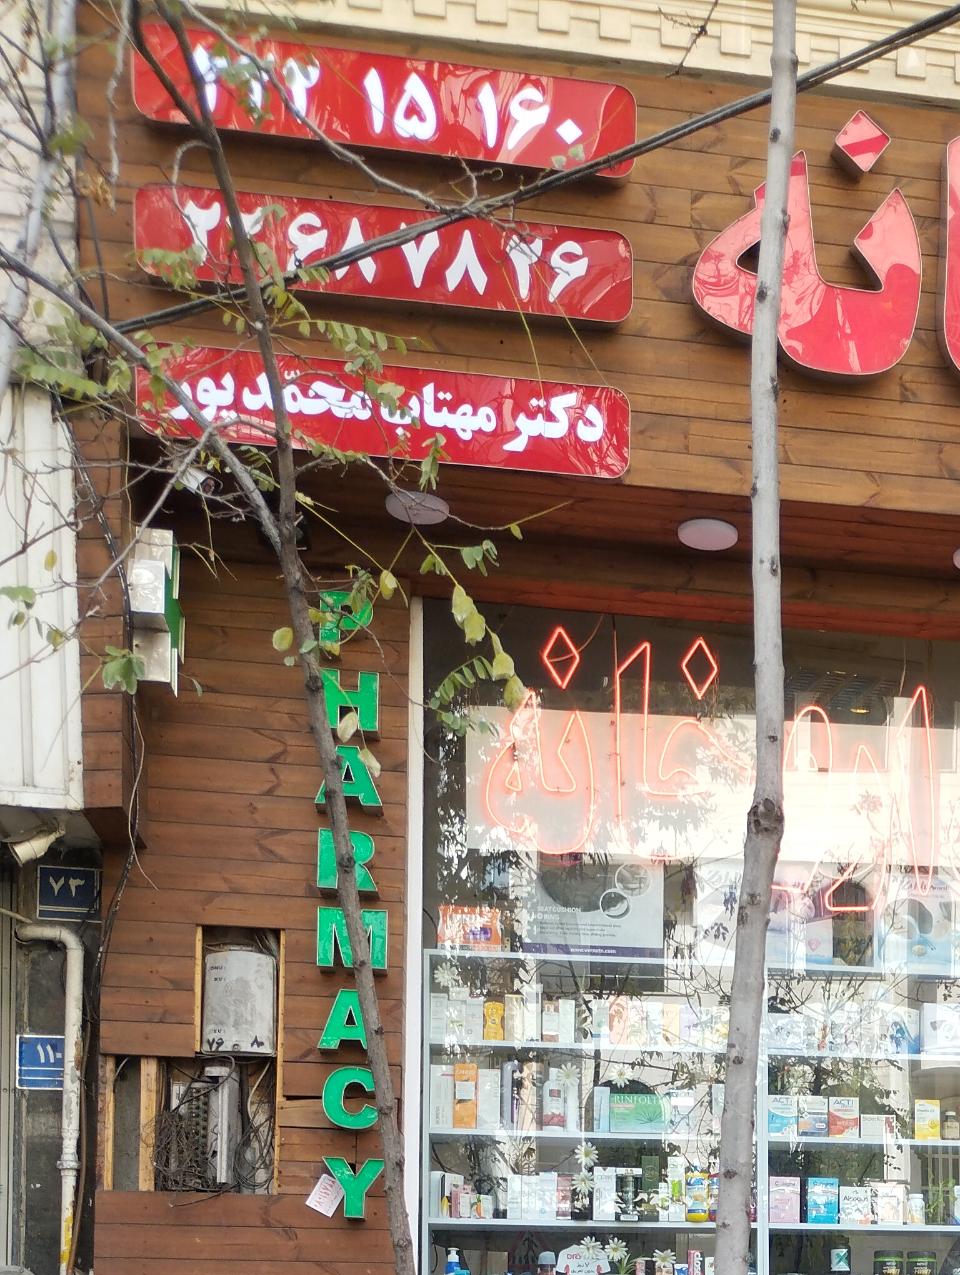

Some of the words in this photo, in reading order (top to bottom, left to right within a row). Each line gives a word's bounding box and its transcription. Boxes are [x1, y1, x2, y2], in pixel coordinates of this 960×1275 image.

[363, 66, 438, 141] ۱۵
[477, 82, 583, 151] ۱۶۰
[503, 392, 604, 452] دکتر
[314, 590, 389, 1219] PHARMACY
